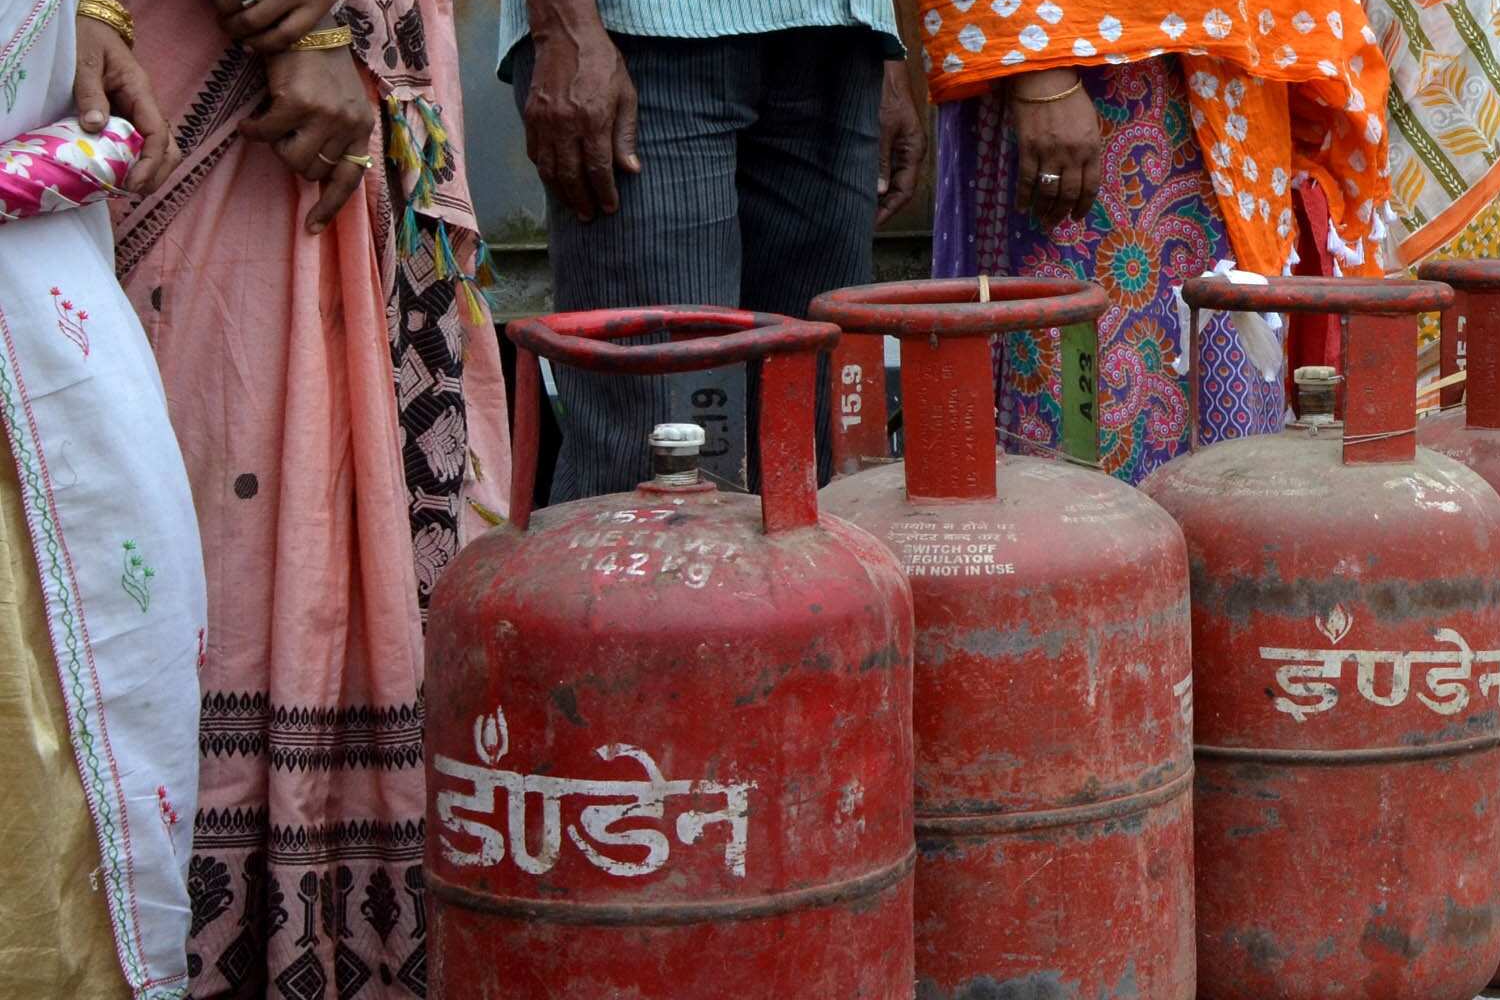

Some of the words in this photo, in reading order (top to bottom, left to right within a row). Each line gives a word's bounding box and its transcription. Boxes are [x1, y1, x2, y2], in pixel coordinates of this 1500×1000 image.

[841, 364, 862, 433] 15.9
[903, 544, 962, 554] SWITCH
[967, 544, 997, 554] OFF
[930, 566, 960, 576] NOT
[965, 565, 981, 576] IN
[985, 564, 1015, 576] USE
